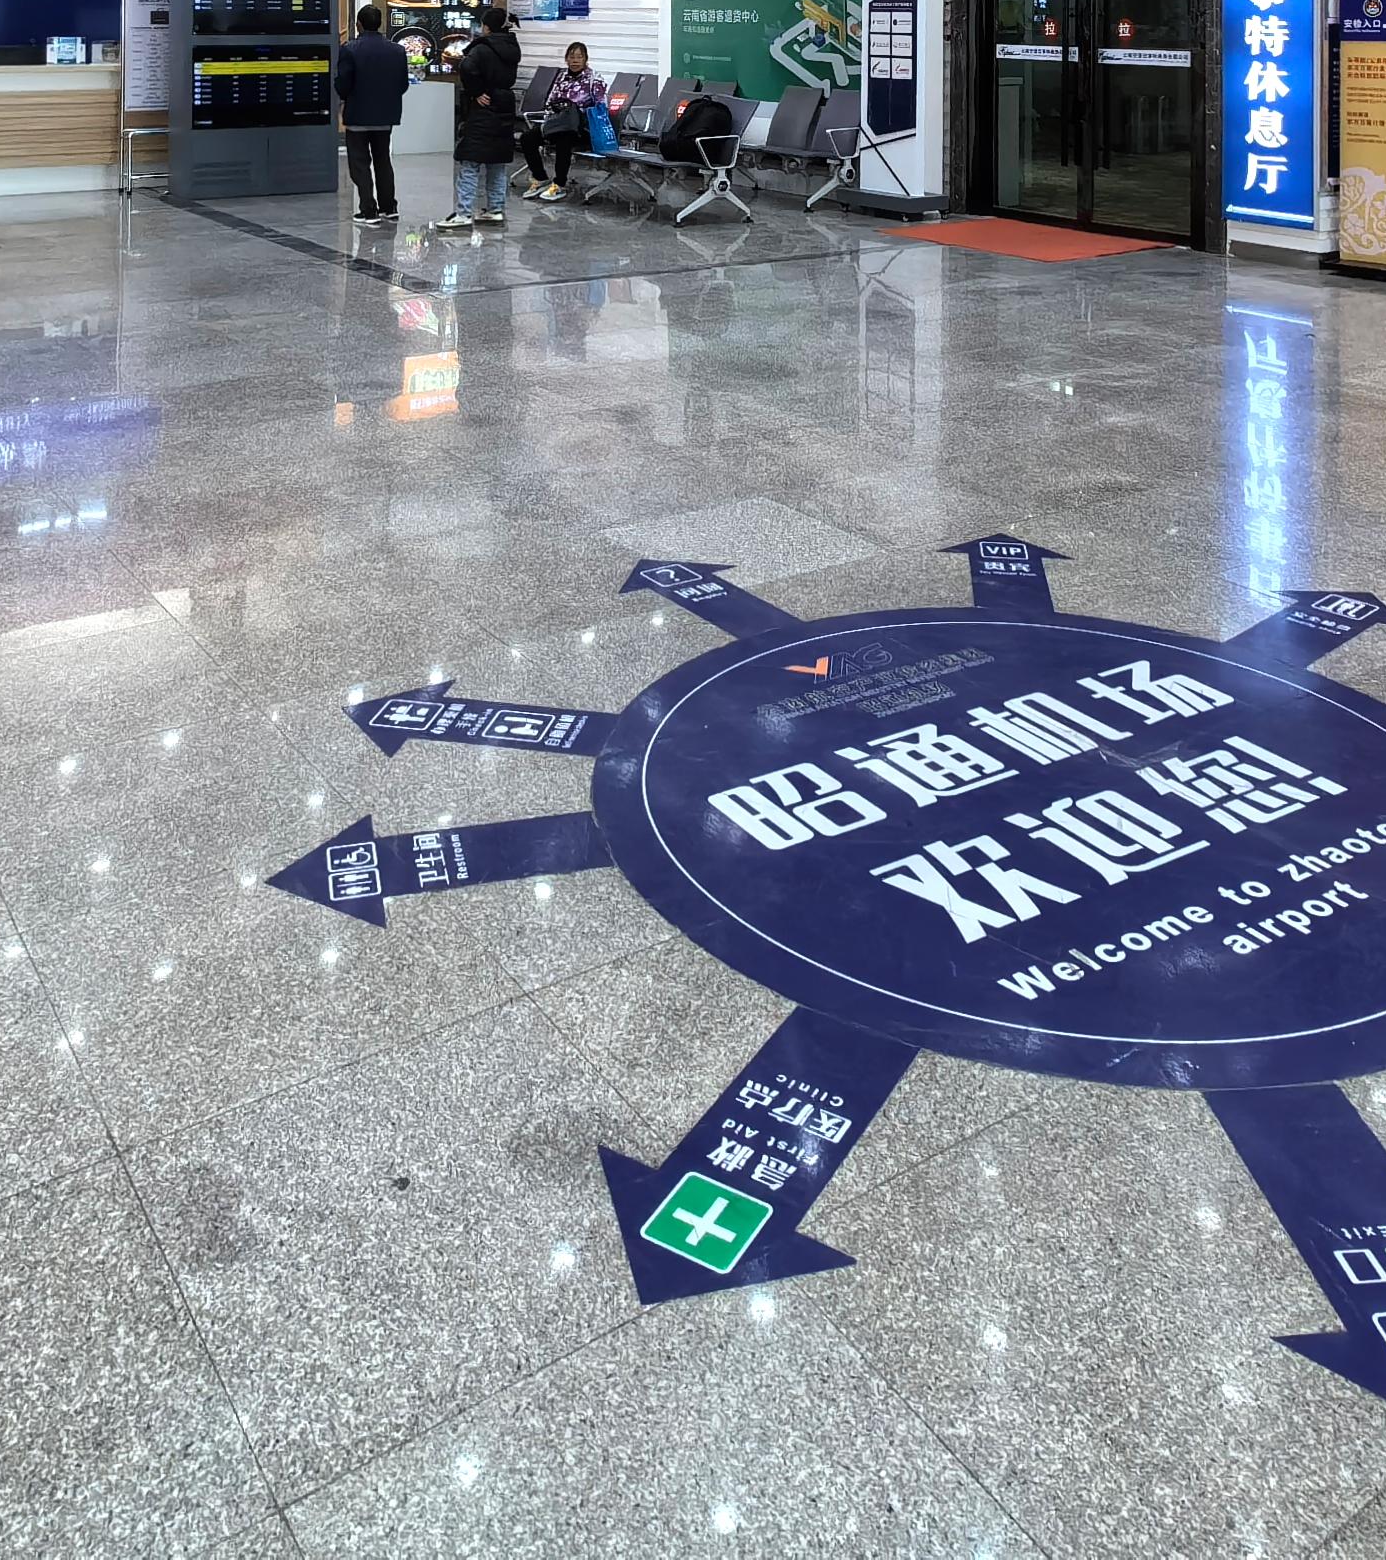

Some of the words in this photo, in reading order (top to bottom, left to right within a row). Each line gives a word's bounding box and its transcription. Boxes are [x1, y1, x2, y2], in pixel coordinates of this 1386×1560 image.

[1044, 21, 1057, 36] 拉
[1117, 22, 1131, 37] 拉
[1343, 18, 1382, 30] 安检入口
[985, 545, 1022, 556] VIP
[707, 659, 1236, 851] 昭通机场
[412, 832, 450, 889] 卫生间
[450, 833, 470, 881] Restroom
[996, 898, 1215, 1002] Welcome
[1217, 875, 1273, 907] to
[1222, 880, 1370, 957] airport
[775, 1073, 845, 1108] Clinic
[721, 1118, 760, 1139] Aid
[734, 1079, 853, 1144] 医疗点
[705, 1136, 799, 1191] 急救
[766, 1136, 820, 1166] First
